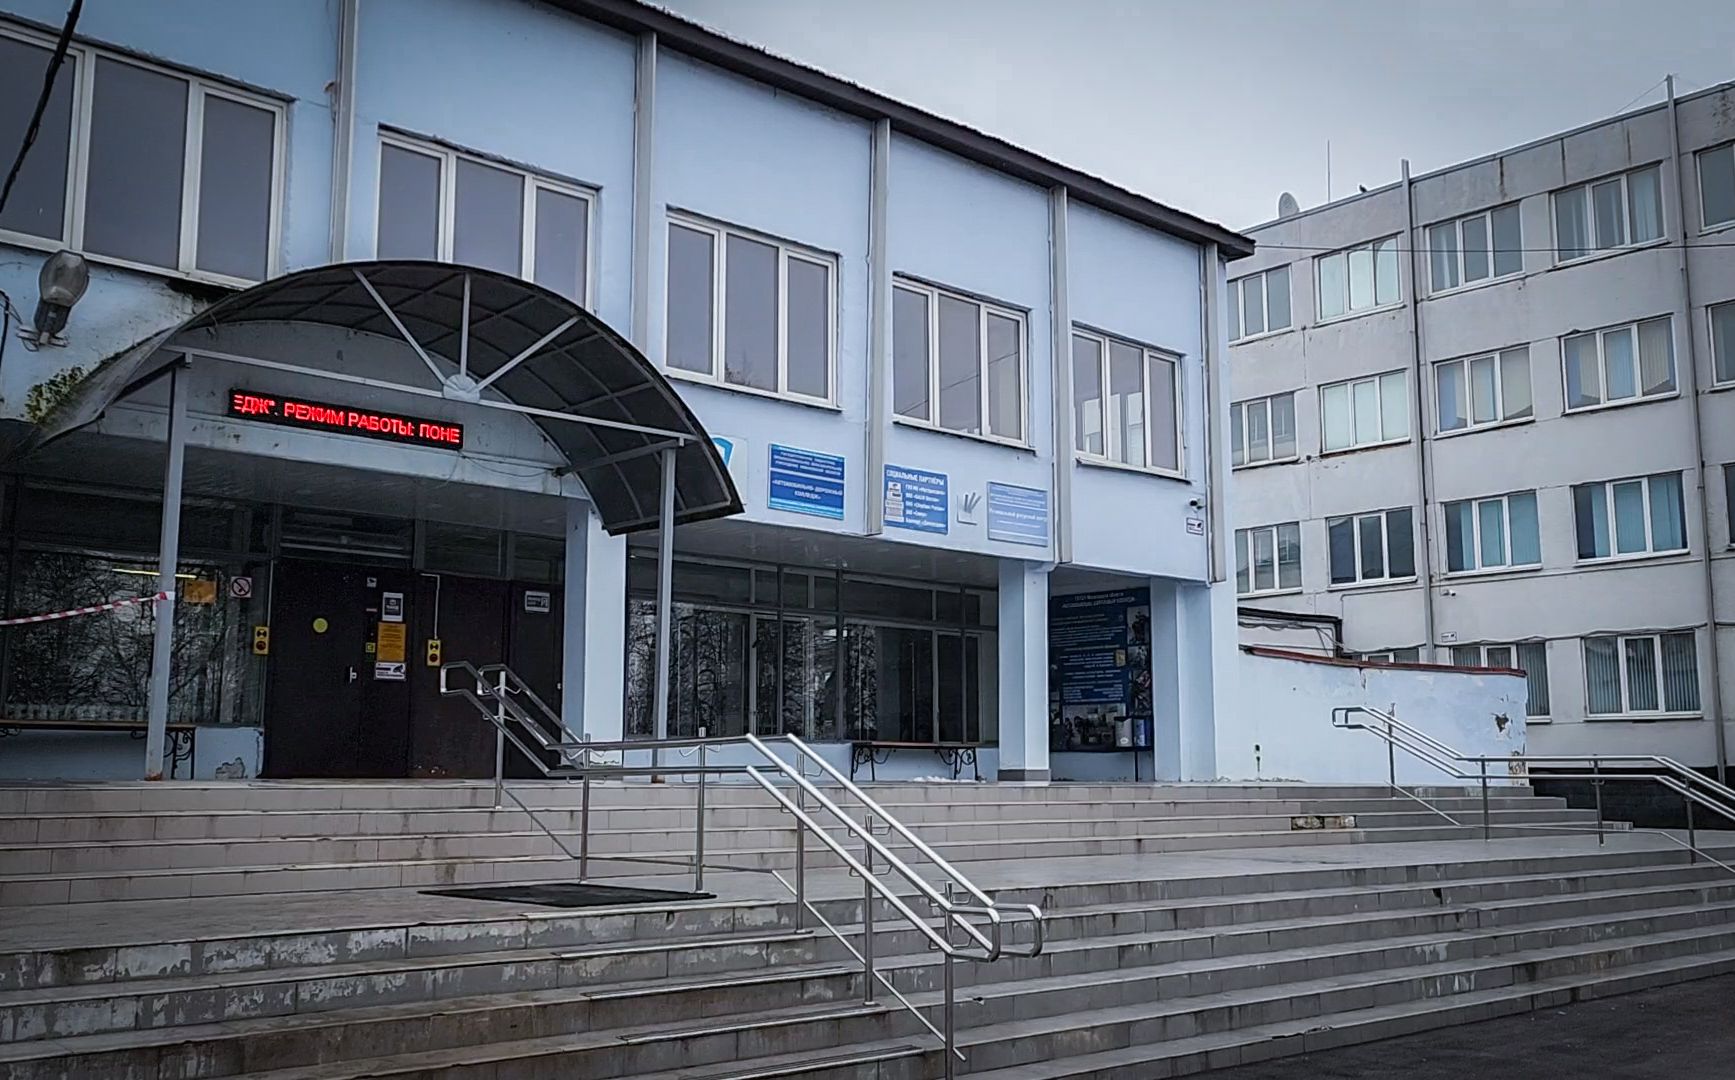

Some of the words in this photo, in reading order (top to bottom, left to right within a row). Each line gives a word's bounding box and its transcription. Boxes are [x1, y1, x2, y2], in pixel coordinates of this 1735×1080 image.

[284, 402, 344, 426] РЕЖИМ
[348, 412, 414, 437] РАБОТЫ:
[419, 425, 460, 443] ПОНЕ
